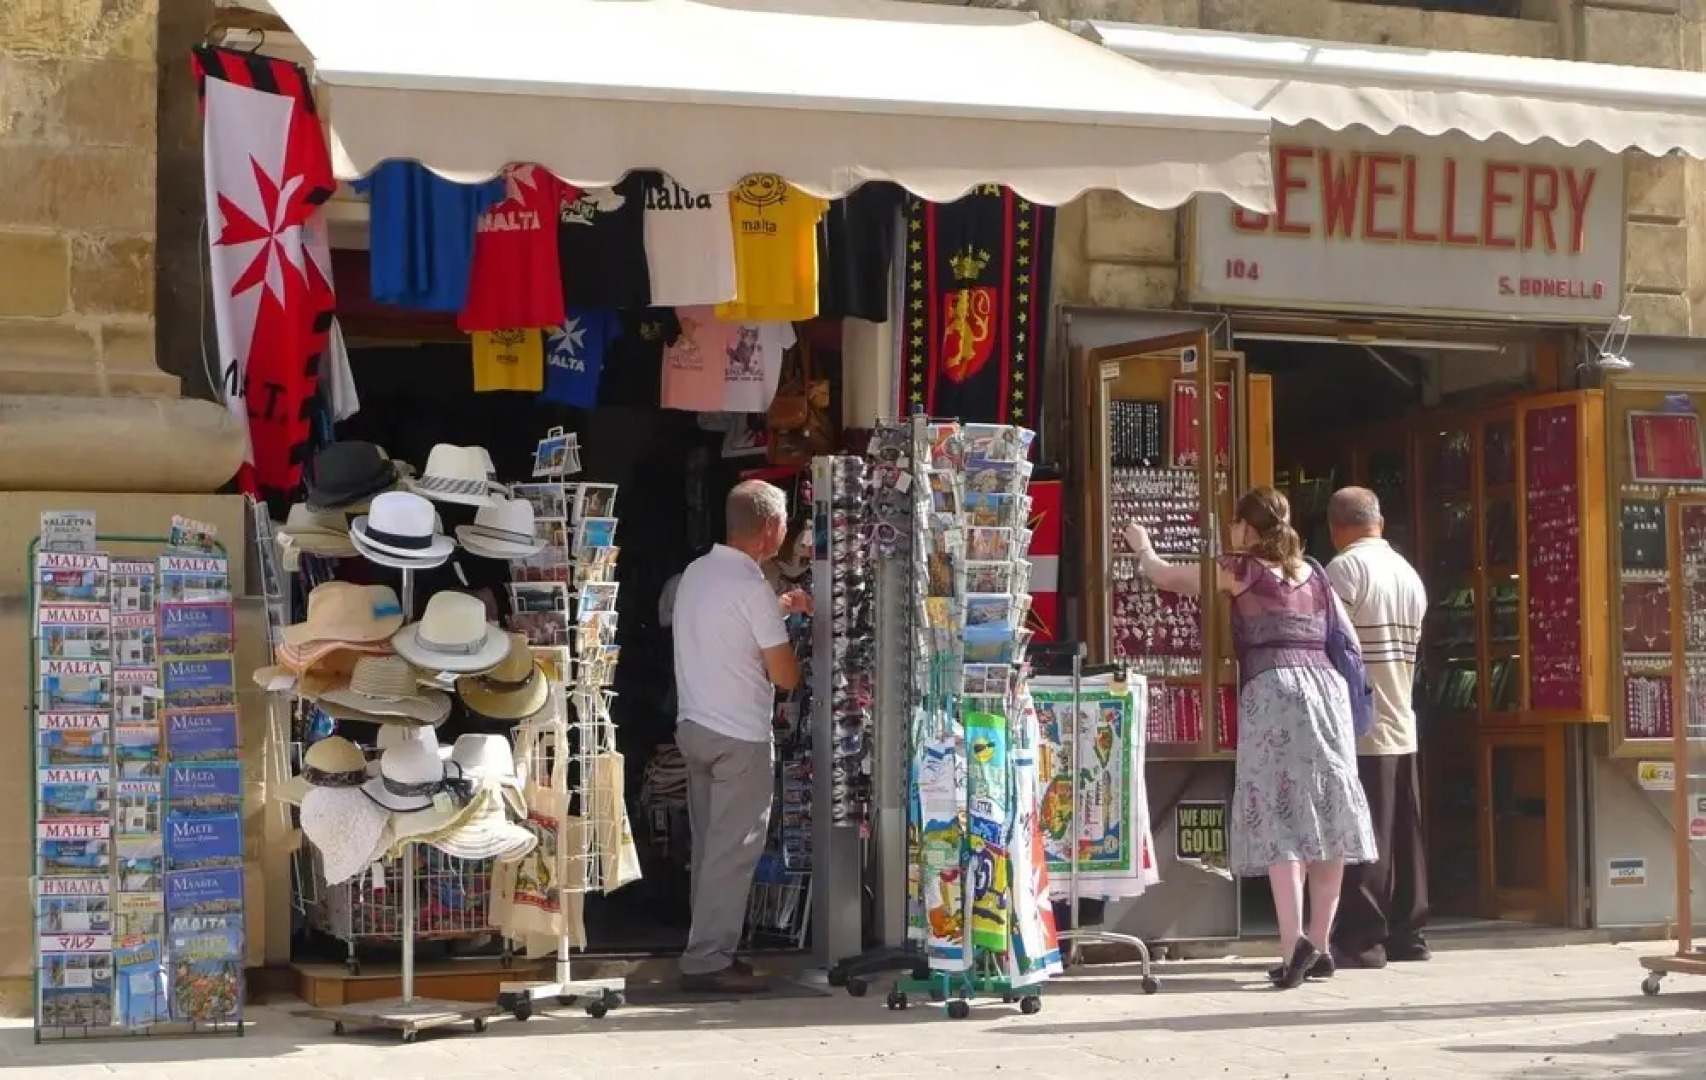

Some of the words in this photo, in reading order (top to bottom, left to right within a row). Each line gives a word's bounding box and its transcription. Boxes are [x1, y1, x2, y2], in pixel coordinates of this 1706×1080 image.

[1226, 258, 1260, 281] 104
[1519, 278, 1604, 300] BONELLO
[45, 554, 100, 569] MALTA
[168, 559, 220, 572] MALTA
[49, 661, 103, 675] MALTA
[46, 715, 101, 729] MALTA
[46, 770, 101, 782] MALTA
[1180, 808, 1199, 826] WE
[1200, 808, 1223, 826] BUY
[46, 824, 101, 837] MALTE
[1181, 828, 1223, 853] GOLD
[58, 936, 95, 950] マルタ
